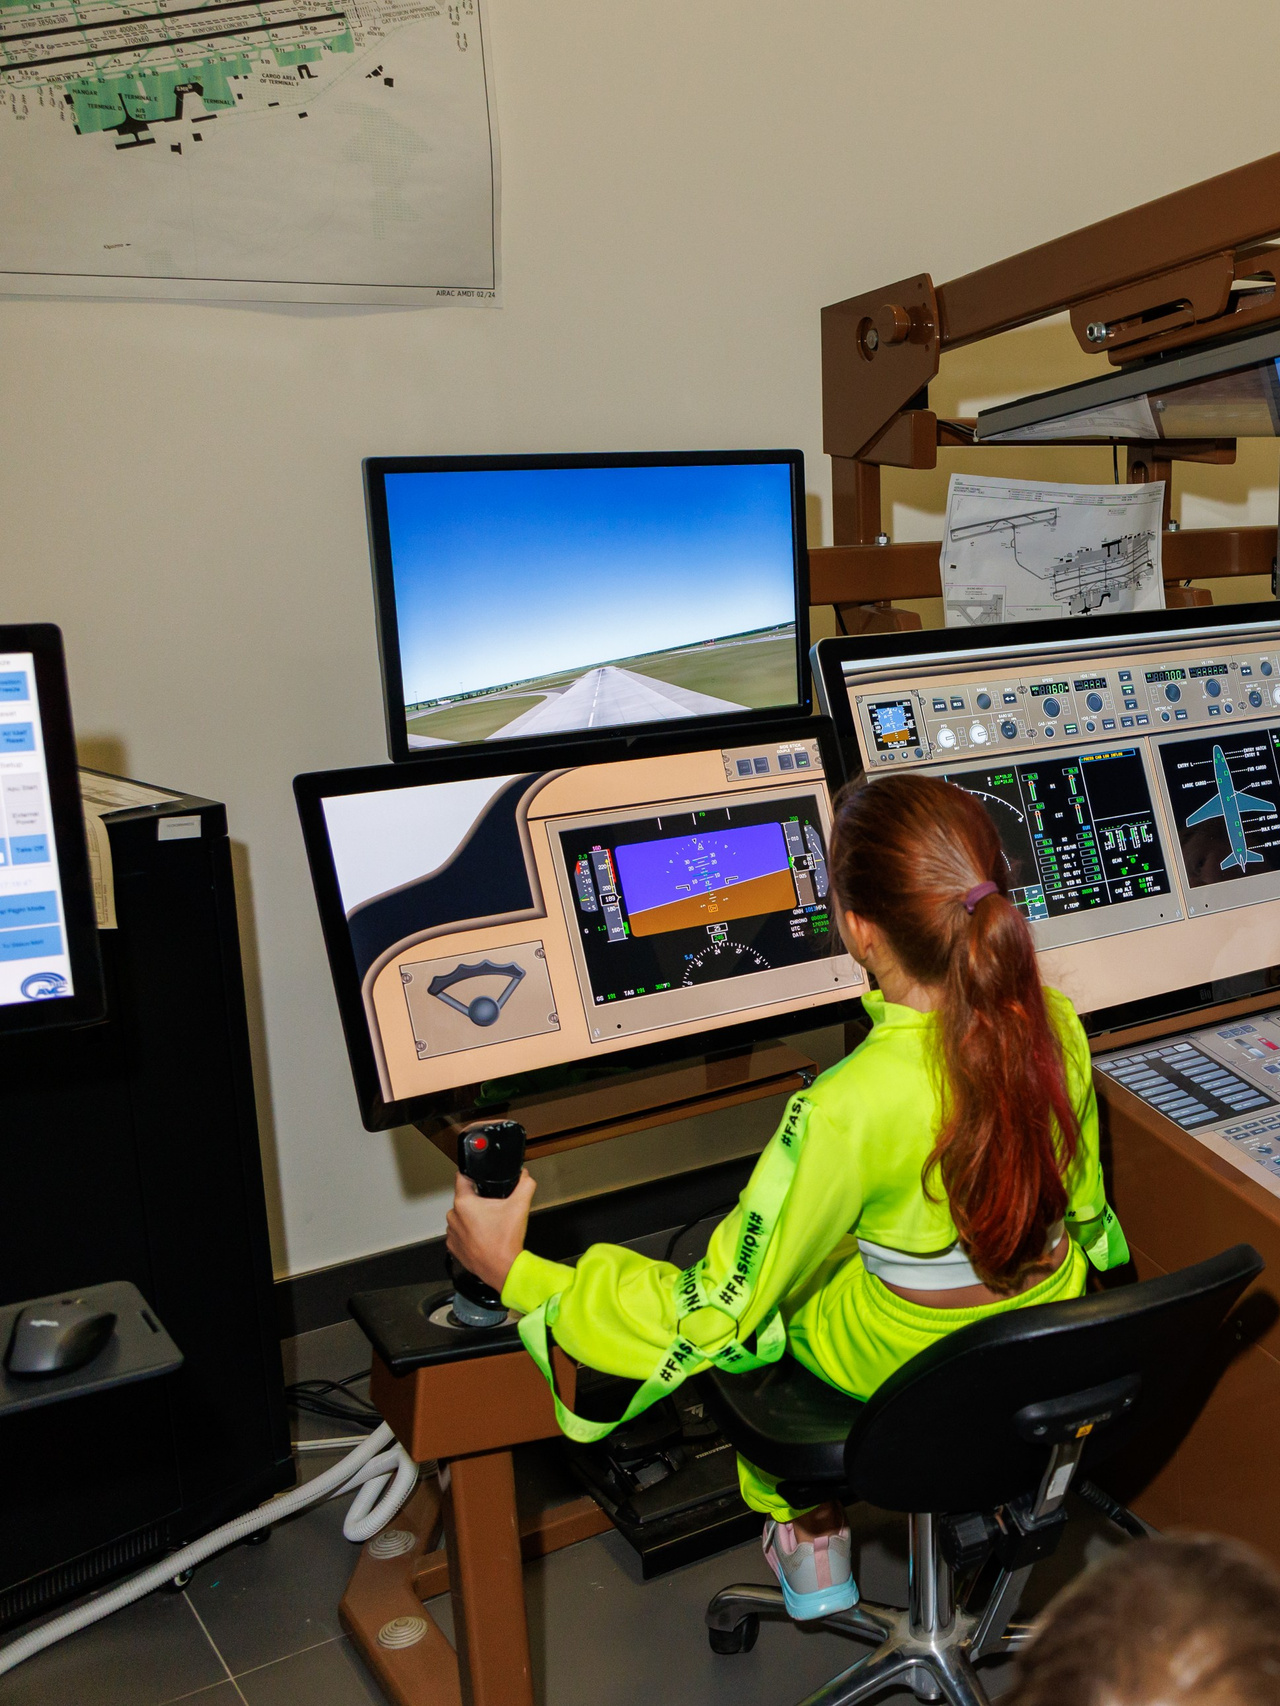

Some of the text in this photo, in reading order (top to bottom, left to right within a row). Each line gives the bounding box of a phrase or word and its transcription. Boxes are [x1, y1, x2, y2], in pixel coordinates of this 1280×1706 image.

[124, 93, 153, 102] TERMINAL
[203, 97, 231, 106] TERMINAL
[87, 103, 116, 111] TERMINAL
[456, 290, 475, 298] AMDT
[476, 291, 496, 299] 02/24
[1165, 669, 1182, 681] 700
[1048, 683, 1064, 694] 160
[718, 1211, 763, 1305] #FASHION#
